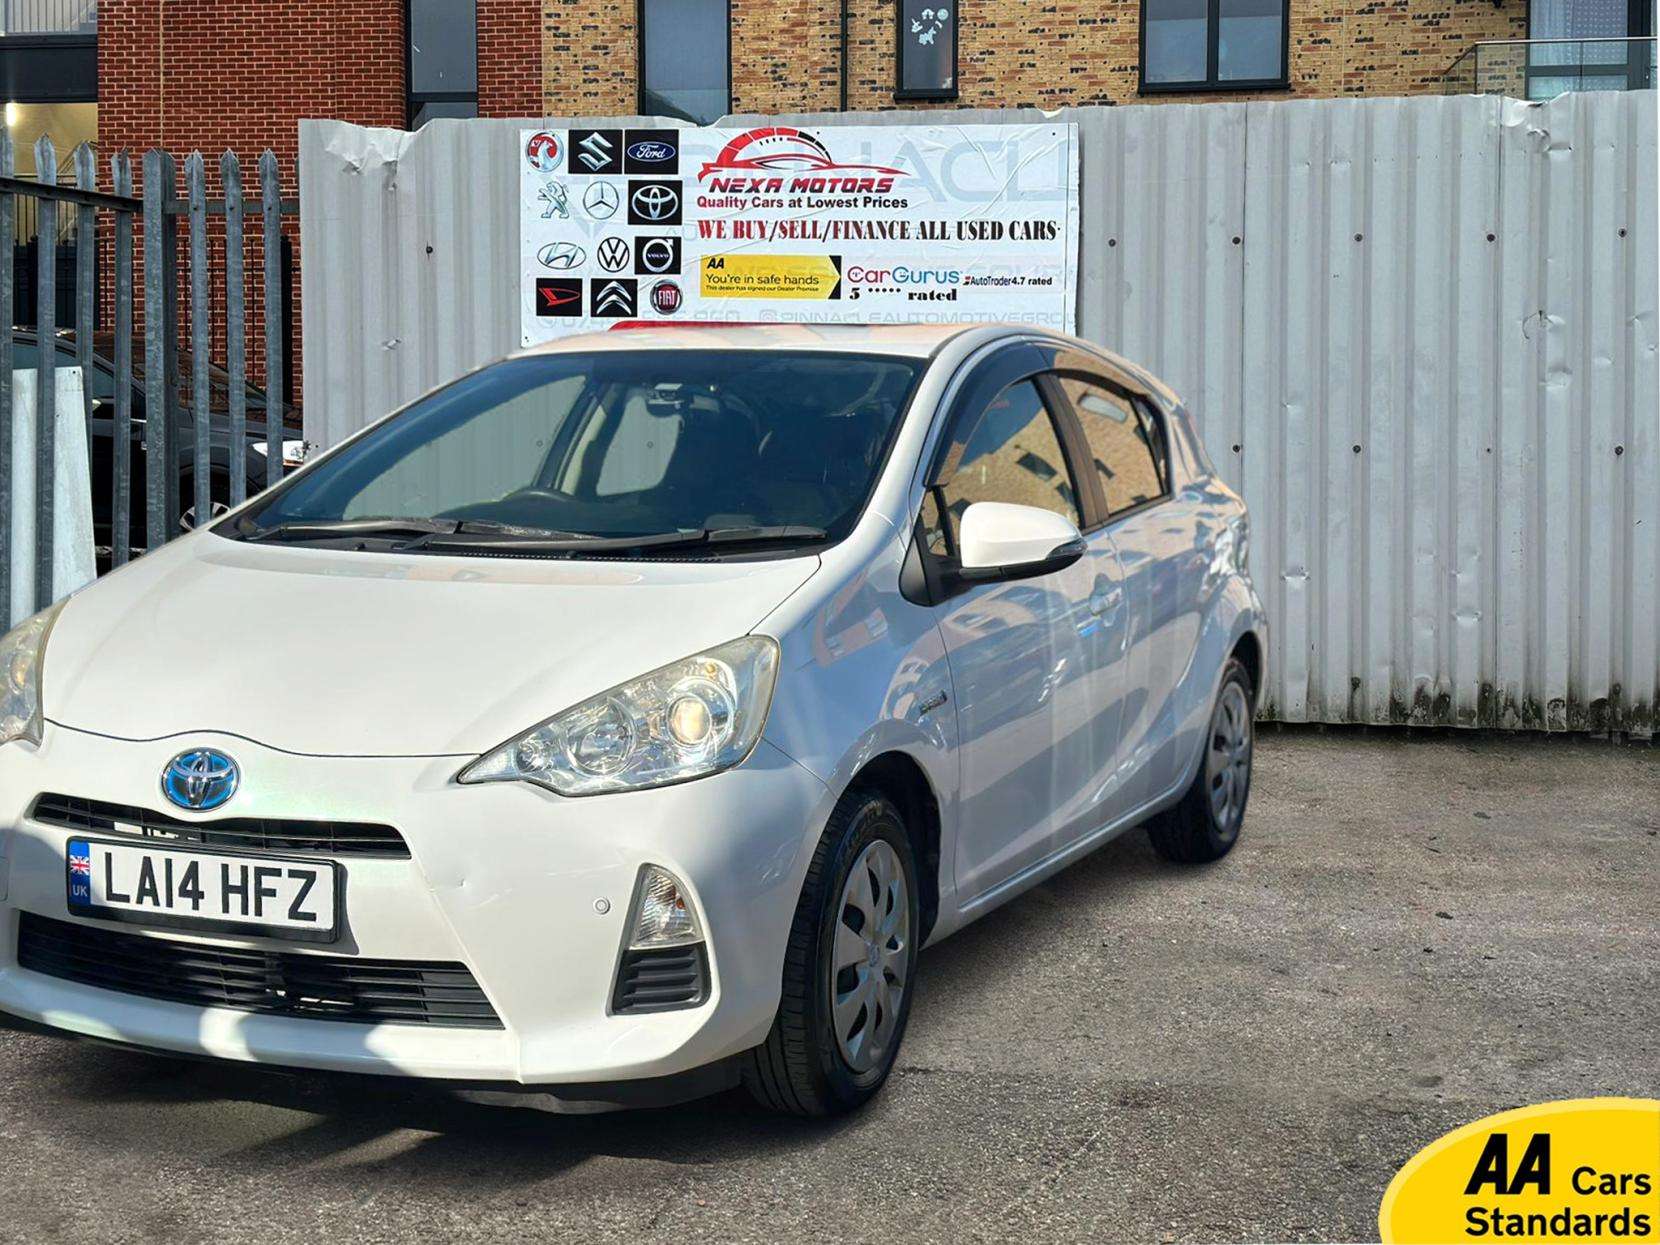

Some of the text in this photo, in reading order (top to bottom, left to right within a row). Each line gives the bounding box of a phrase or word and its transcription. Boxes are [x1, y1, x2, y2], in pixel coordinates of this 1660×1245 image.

[636, 144, 666, 158] Ford
[709, 178, 895, 193] NEXA MOTORS
[697, 196, 908, 210] Quality Cars at Lowest Prices
[697, 220, 726, 239] WE
[916, 220, 951, 240] ALL
[956, 220, 1004, 240] USED
[706, 257, 725, 269] AA
[706, 273, 820, 285] You're in safe hands
[847, 266, 960, 284] CarGurus
[1028, 277, 1053, 286] rated
[658, 290, 677, 306] FIAT
[849, 287, 957, 301] 5 rated
[72, 851, 317, 922] UK LA14 HFZ
